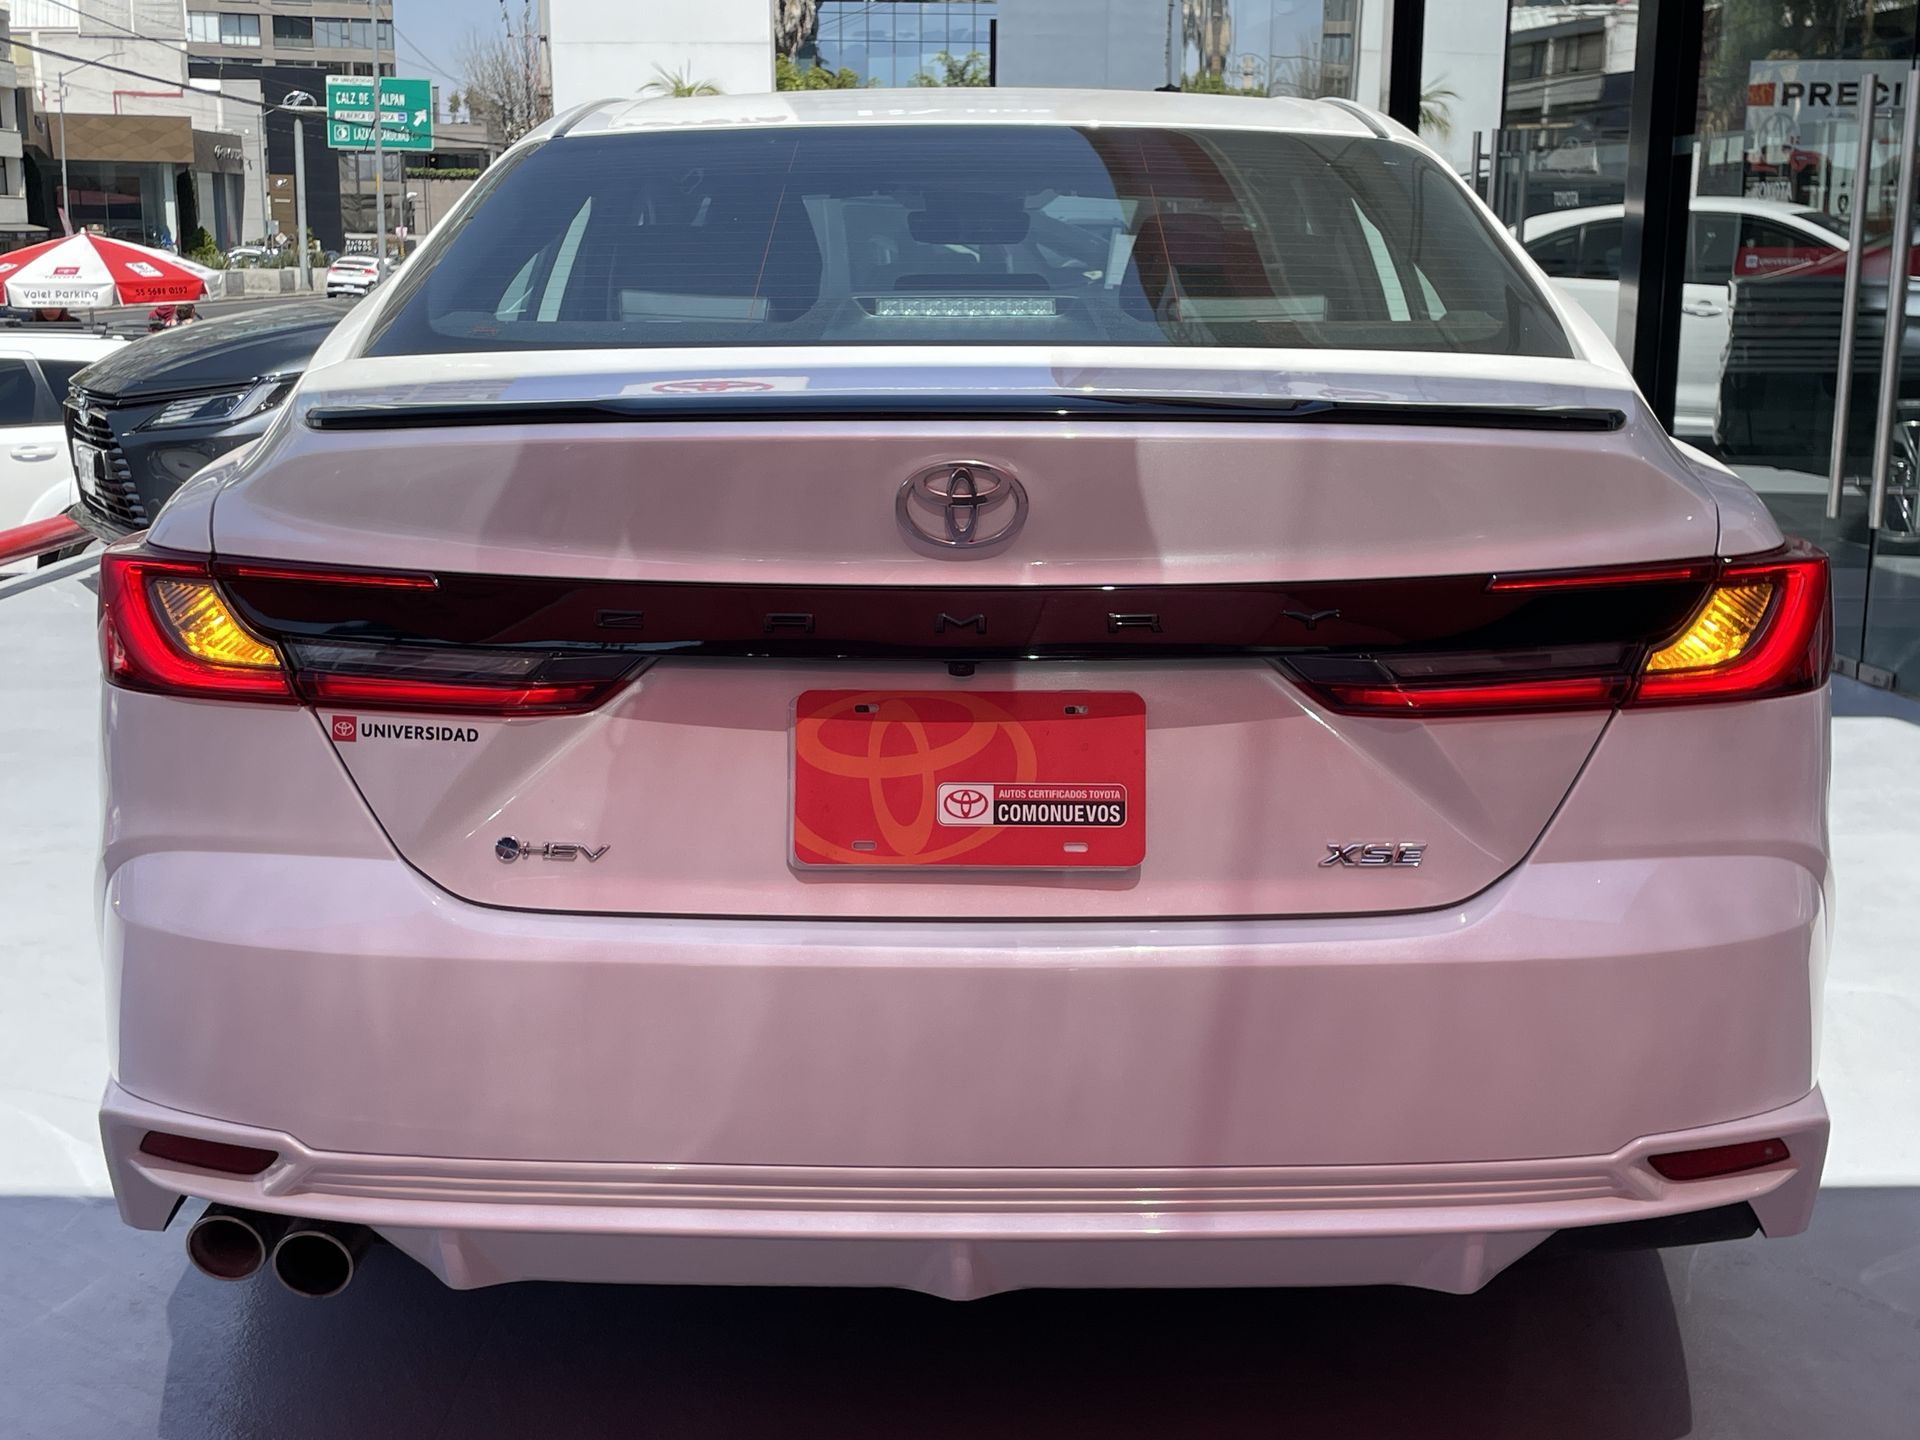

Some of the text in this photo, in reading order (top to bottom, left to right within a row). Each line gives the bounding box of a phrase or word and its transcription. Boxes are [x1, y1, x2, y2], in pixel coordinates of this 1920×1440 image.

[335, 91, 356, 104] CALZ
[358, 92, 370, 105] DE
[23, 290, 99, 300] Valet Parking
[361, 723, 479, 742] UNIVERSIDAD
[999, 789, 1121, 799] AUTOS CERTIFICADOS TOYOTA
[998, 803, 1121, 822] COMONUEVOS
[521, 841, 611, 862] HEV
[1318, 842, 1428, 867] XSE
